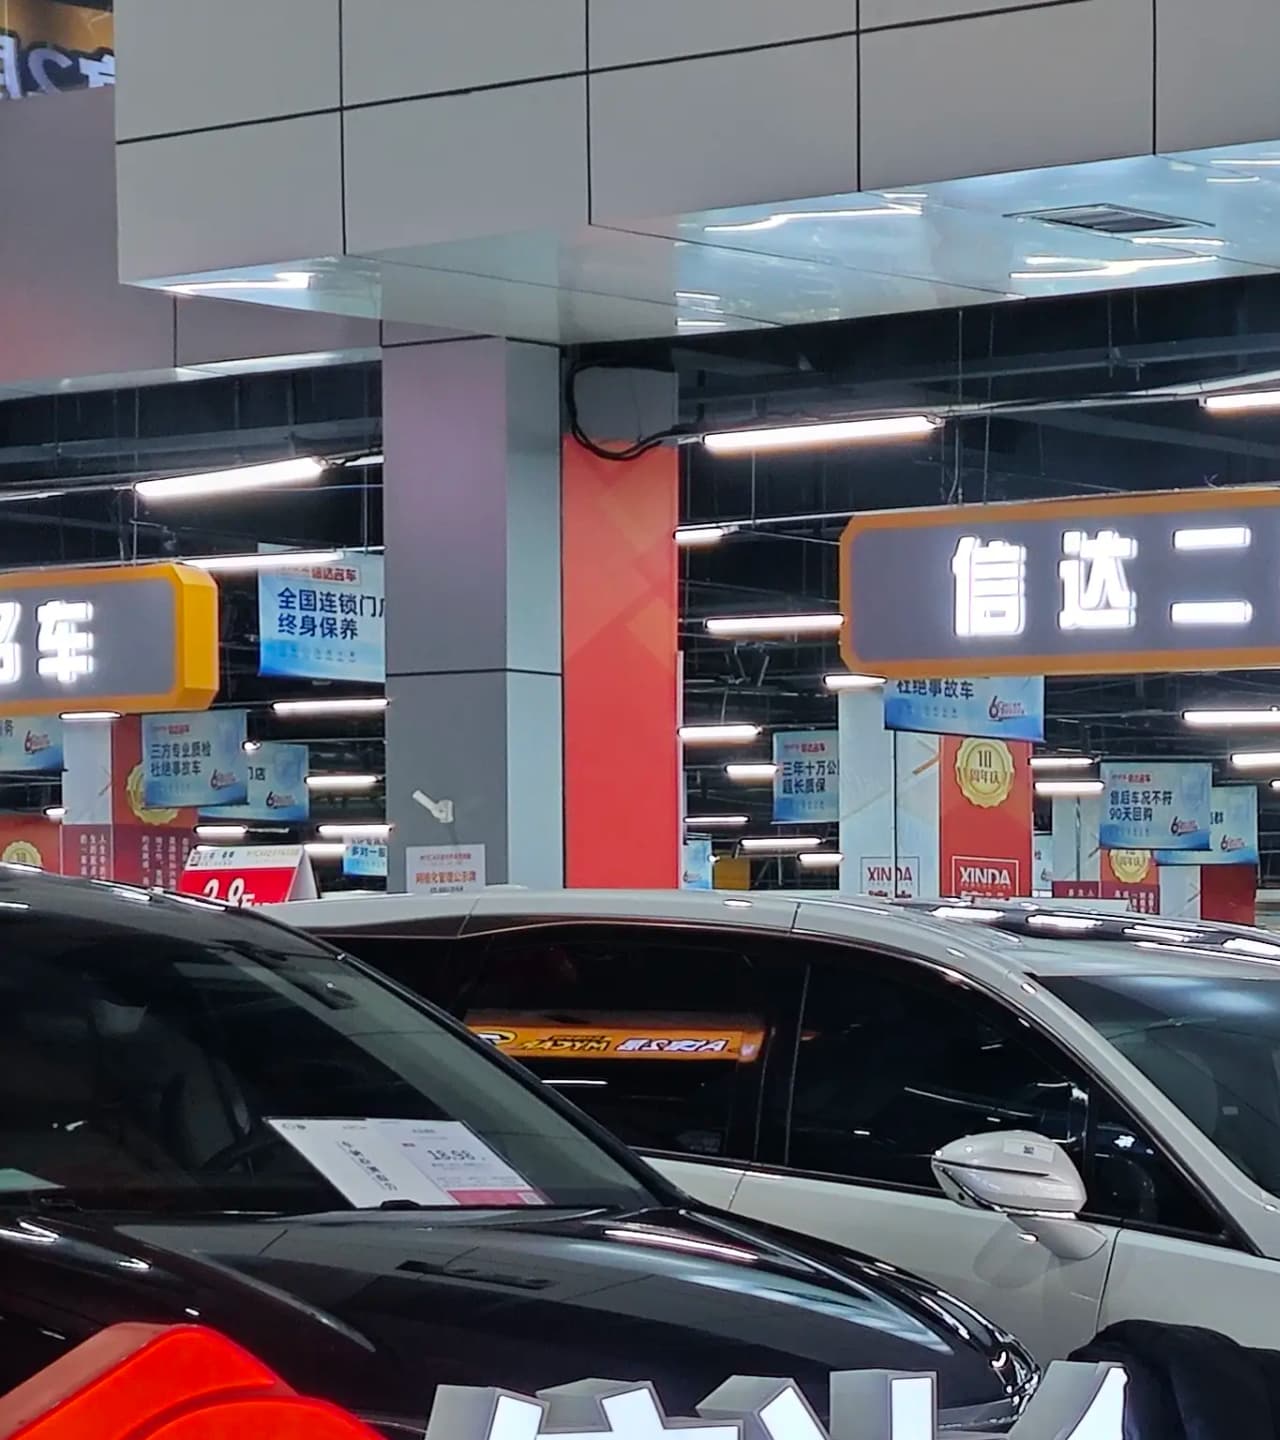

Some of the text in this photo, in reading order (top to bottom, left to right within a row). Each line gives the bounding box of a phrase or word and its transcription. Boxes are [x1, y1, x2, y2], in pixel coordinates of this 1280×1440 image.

[277, 612, 359, 641] 终身保养
[0, 600, 95, 684] 车
[151, 741, 212, 760] 三方专业质检
[151, 761, 202, 778] 杜绝事故车
[782, 760, 839, 777] 三年十万公
[968, 768, 1000, 786] 周年庆
[782, 777, 826, 795] 超长质保
[1110, 790, 1173, 807] 售后车况不符
[1109, 808, 1153, 823] 90天回购
[866, 866, 913, 884] XINDA
[959, 866, 1011, 885] XINDA
